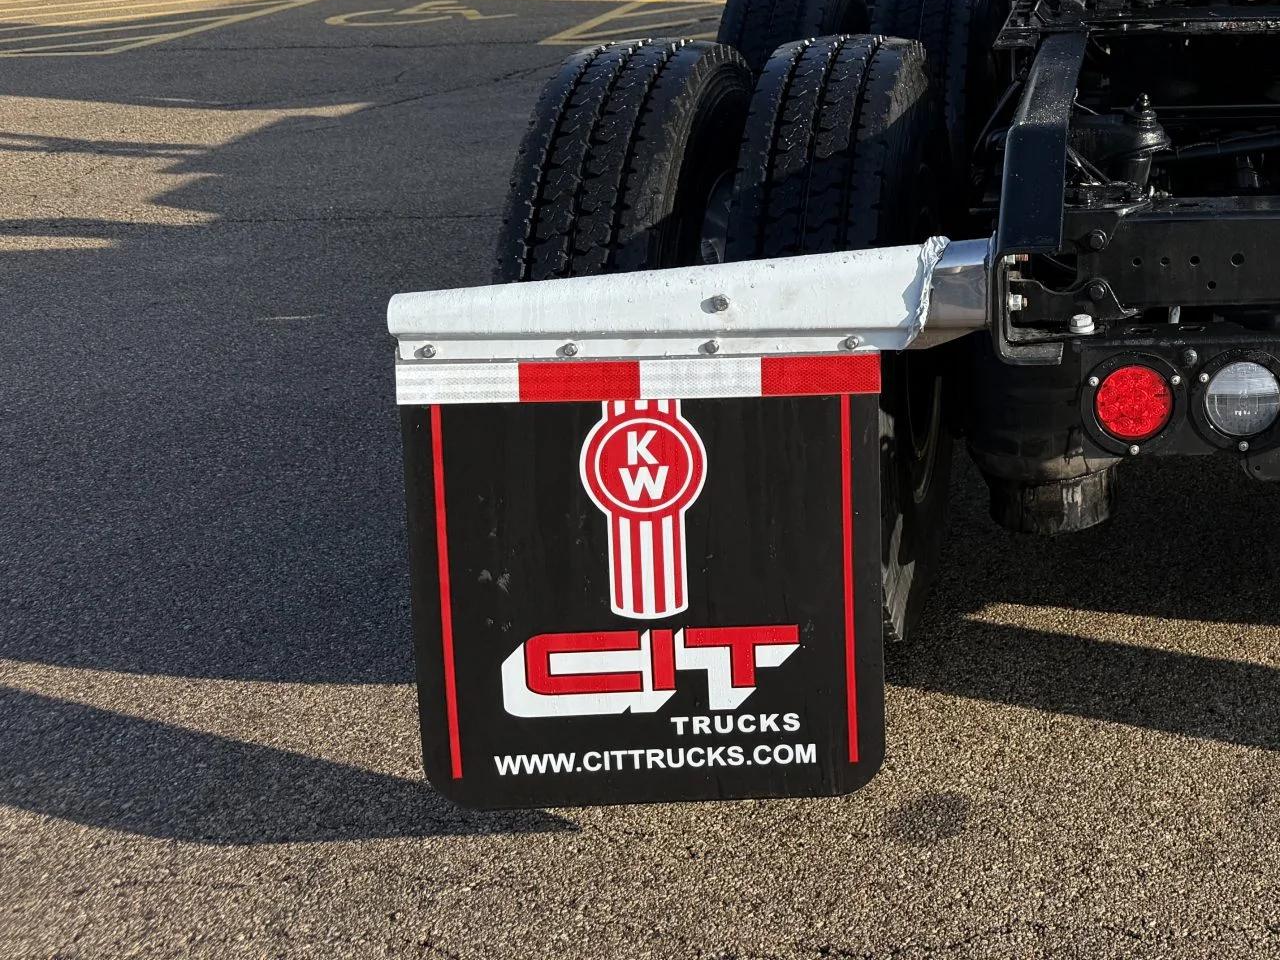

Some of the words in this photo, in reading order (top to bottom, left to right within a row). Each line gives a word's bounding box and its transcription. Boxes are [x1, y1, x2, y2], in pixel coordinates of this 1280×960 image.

[501, 624, 801, 718] CIT
[670, 712, 801, 736] TRUCKS
[494, 743, 818, 777] WWW.CITTRUCKS.COM
